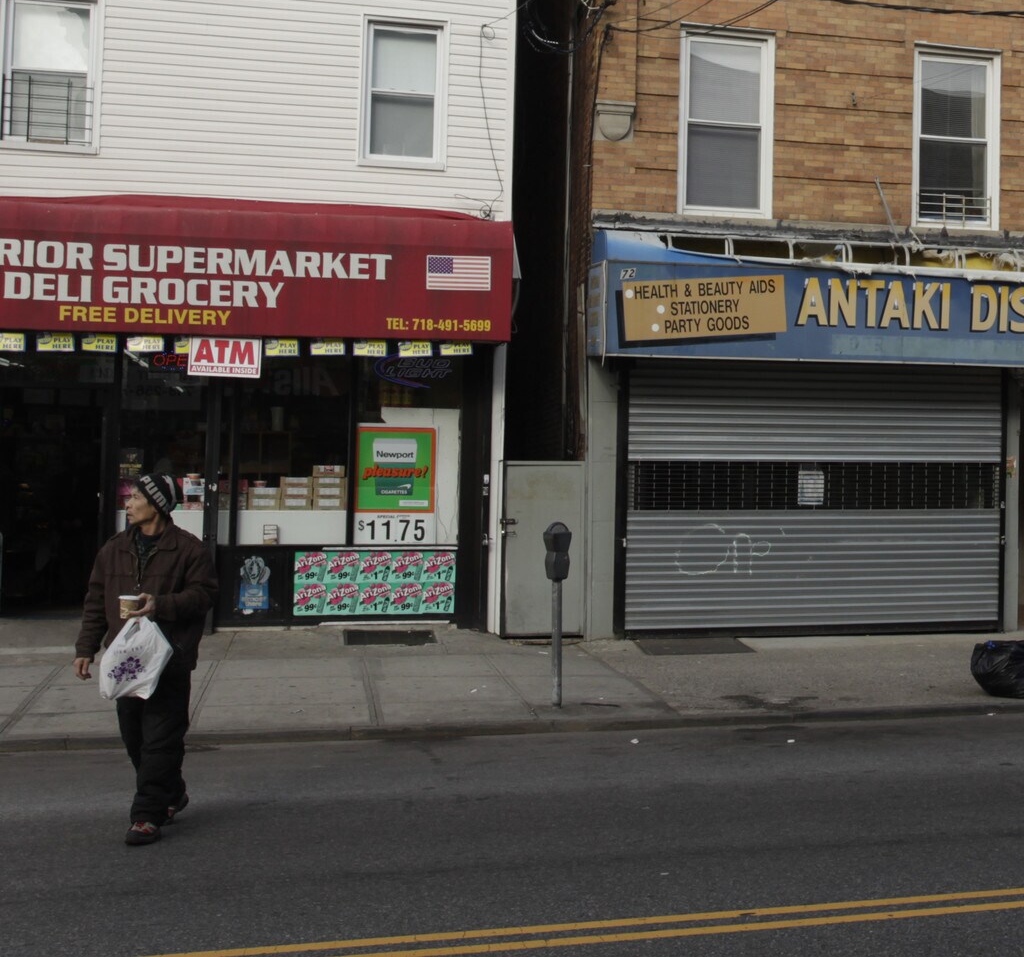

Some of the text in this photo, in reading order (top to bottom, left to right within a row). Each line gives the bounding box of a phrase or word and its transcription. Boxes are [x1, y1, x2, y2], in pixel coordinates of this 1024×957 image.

[0, 239, 392, 280] RIOR SUPERMARKET
[622, 269, 635, 279] 72
[4, 271, 285, 308] DELI GROCERY
[634, 279, 776, 300] HEALTH & BEAUTY AIDS
[670, 299, 740, 316] STATIONERY
[796, 277, 951, 331] ANTAKI
[59, 305, 232, 326] FREE DELIVERY
[386, 317, 491, 332] TEL: 718-491-5699
[664, 316, 750, 334] PARTY GOODS
[153, 354, 188, 366] OPE
[194, 339, 254, 365] ATM
[191, 366, 257, 375] AVAILABLE INSIDE
[398, 358, 451, 368] BUD
[385, 366, 452, 378] LIGHT
[376, 450, 414, 459] Newport
[362, 465, 428, 480] pleasure!
[358, 519, 425, 542] $11.75
